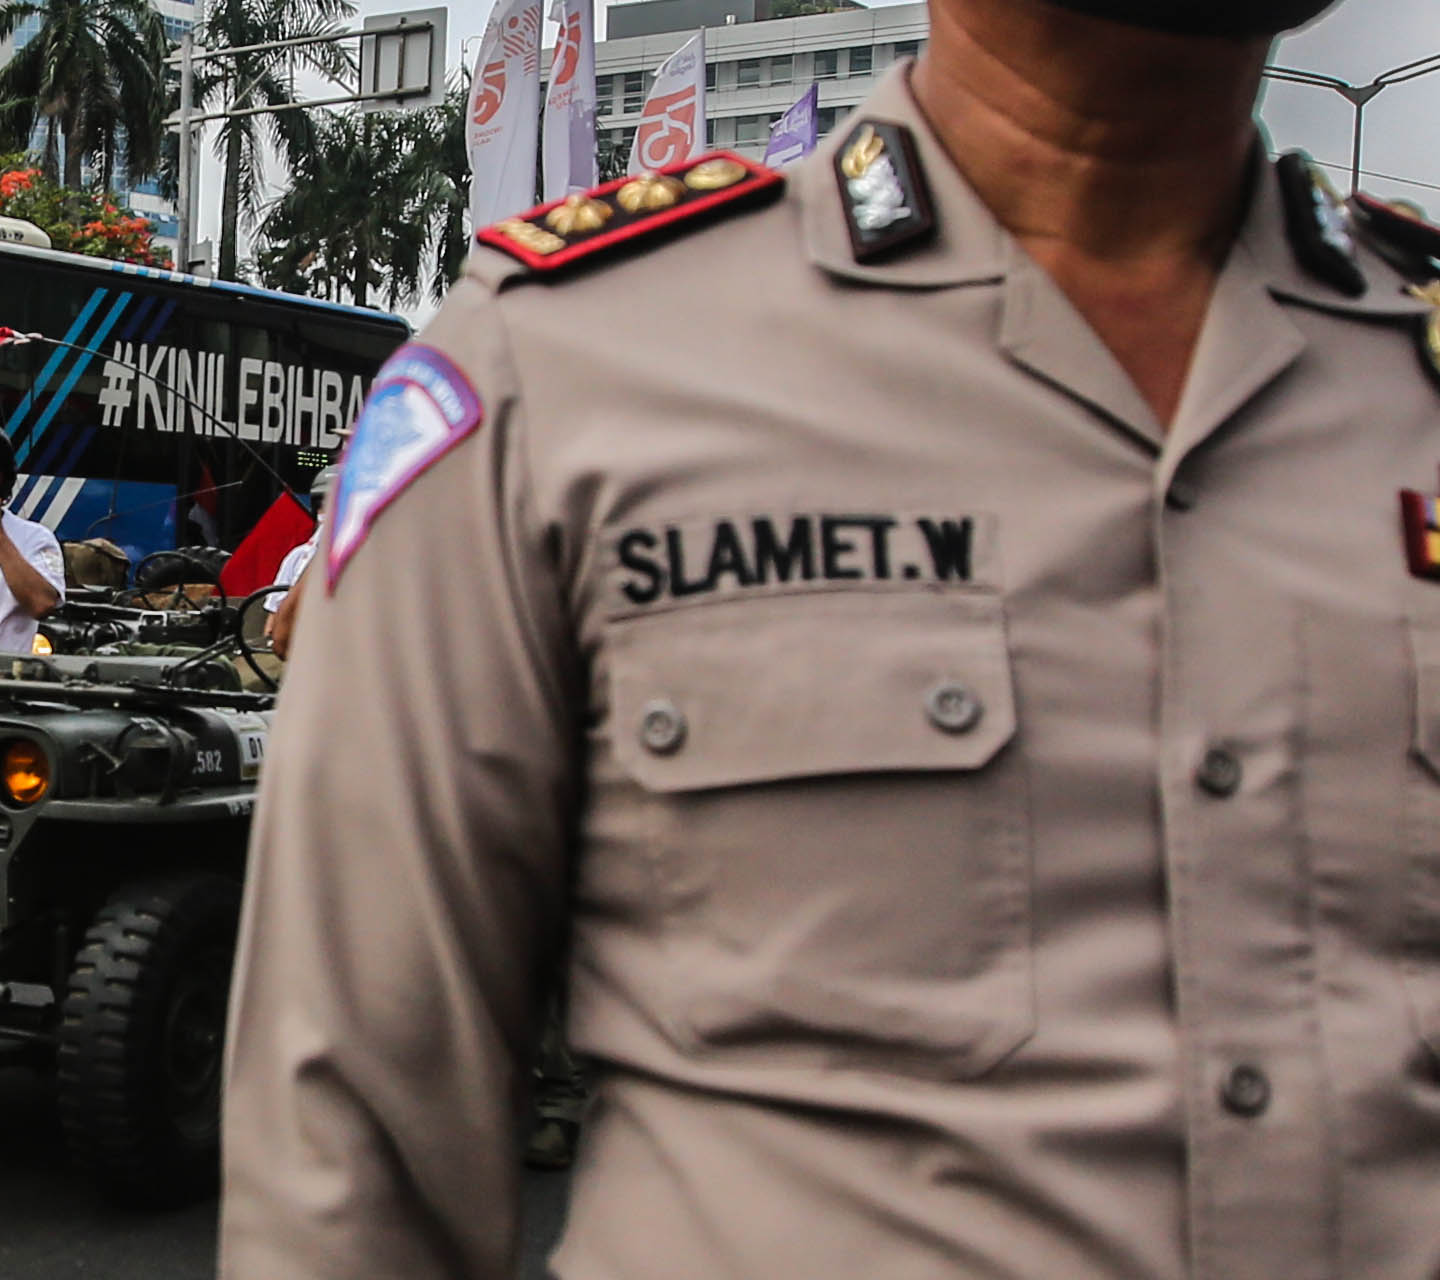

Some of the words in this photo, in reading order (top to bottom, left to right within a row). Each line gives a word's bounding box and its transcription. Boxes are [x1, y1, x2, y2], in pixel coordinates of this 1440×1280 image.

[98, 340, 370, 451] #KINILEBIHBA
[618, 514, 972, 602] SLAMET.W
[192, 750, 223, 774] 582
